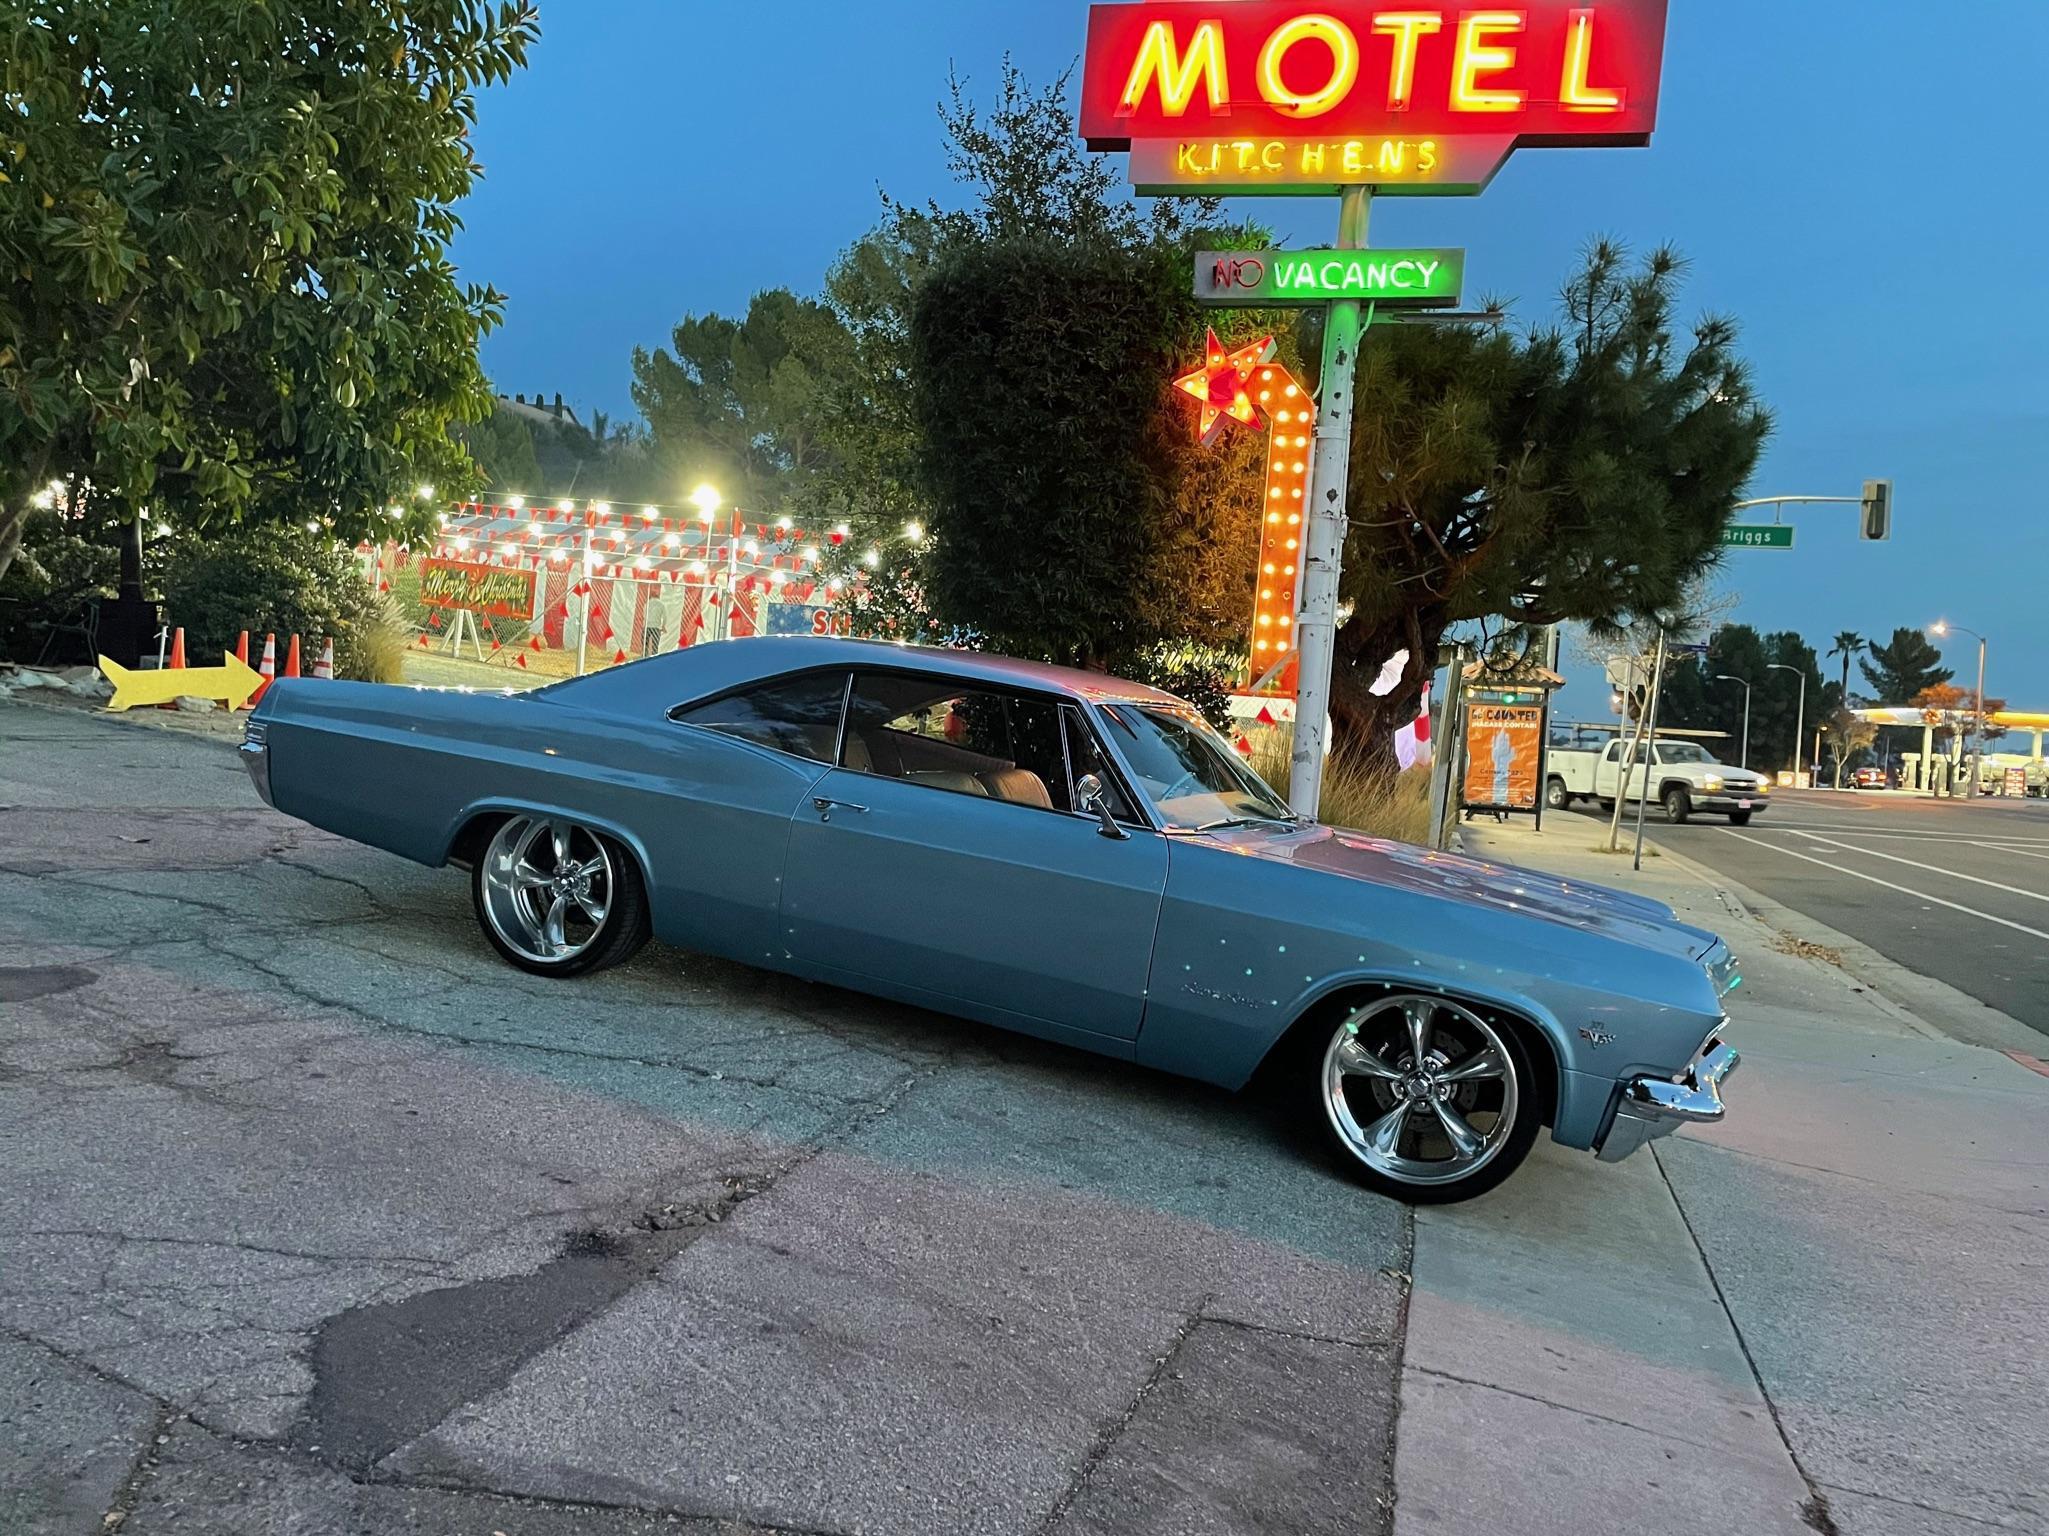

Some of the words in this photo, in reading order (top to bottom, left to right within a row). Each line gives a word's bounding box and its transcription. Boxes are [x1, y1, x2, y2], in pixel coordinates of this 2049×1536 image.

[1116, 9, 1626, 118] MOTEL
[1177, 140, 1437, 174] KITCHENS
[1213, 258, 1264, 289] NO
[1274, 260, 1438, 290] VACANCY
[427, 567, 468, 605] Merry
